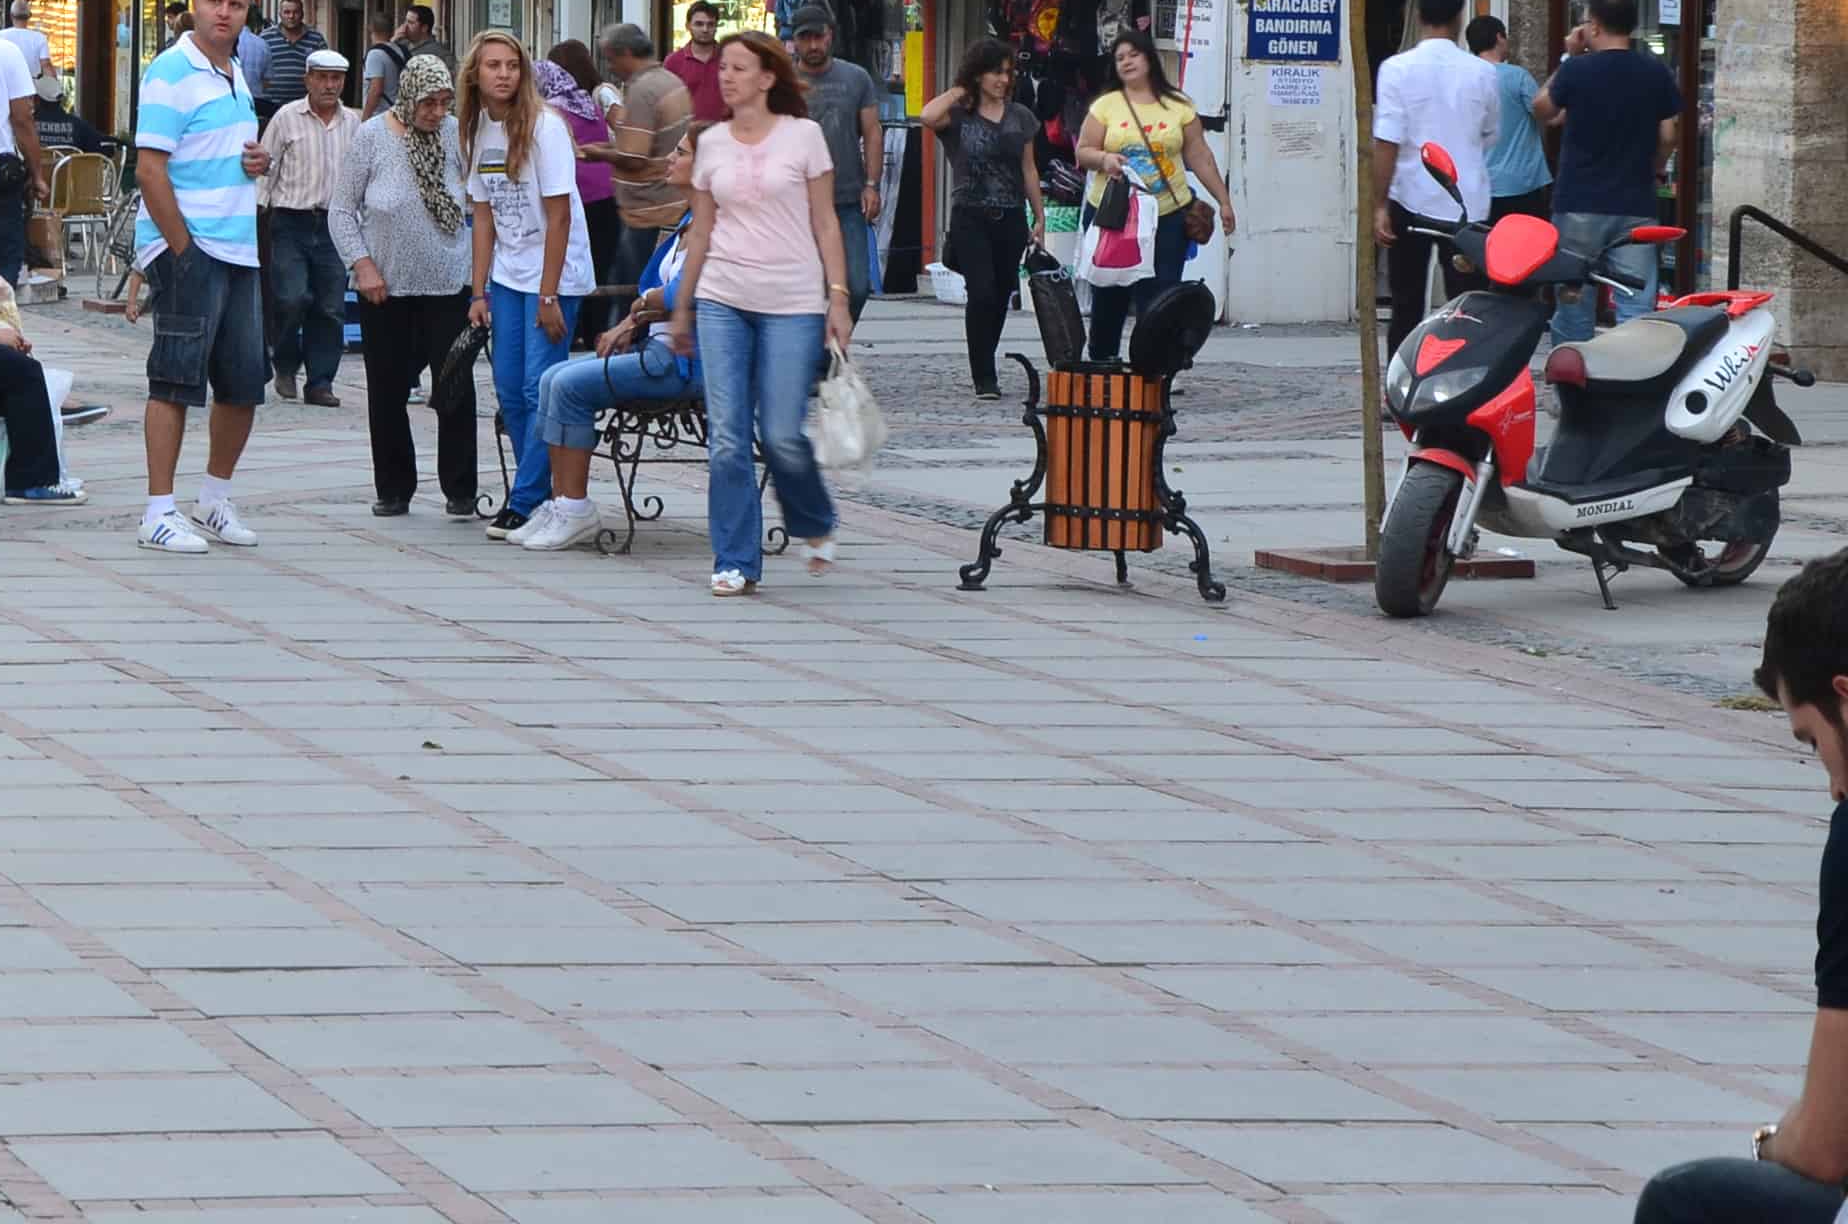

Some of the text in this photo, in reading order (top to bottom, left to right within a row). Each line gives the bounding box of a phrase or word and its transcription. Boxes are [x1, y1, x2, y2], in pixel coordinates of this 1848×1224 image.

[1255, 18, 1333, 35] BANDIRMA
[1267, 37, 1318, 55] GÖNEN
[1576, 499, 1634, 518] MONDIAL
